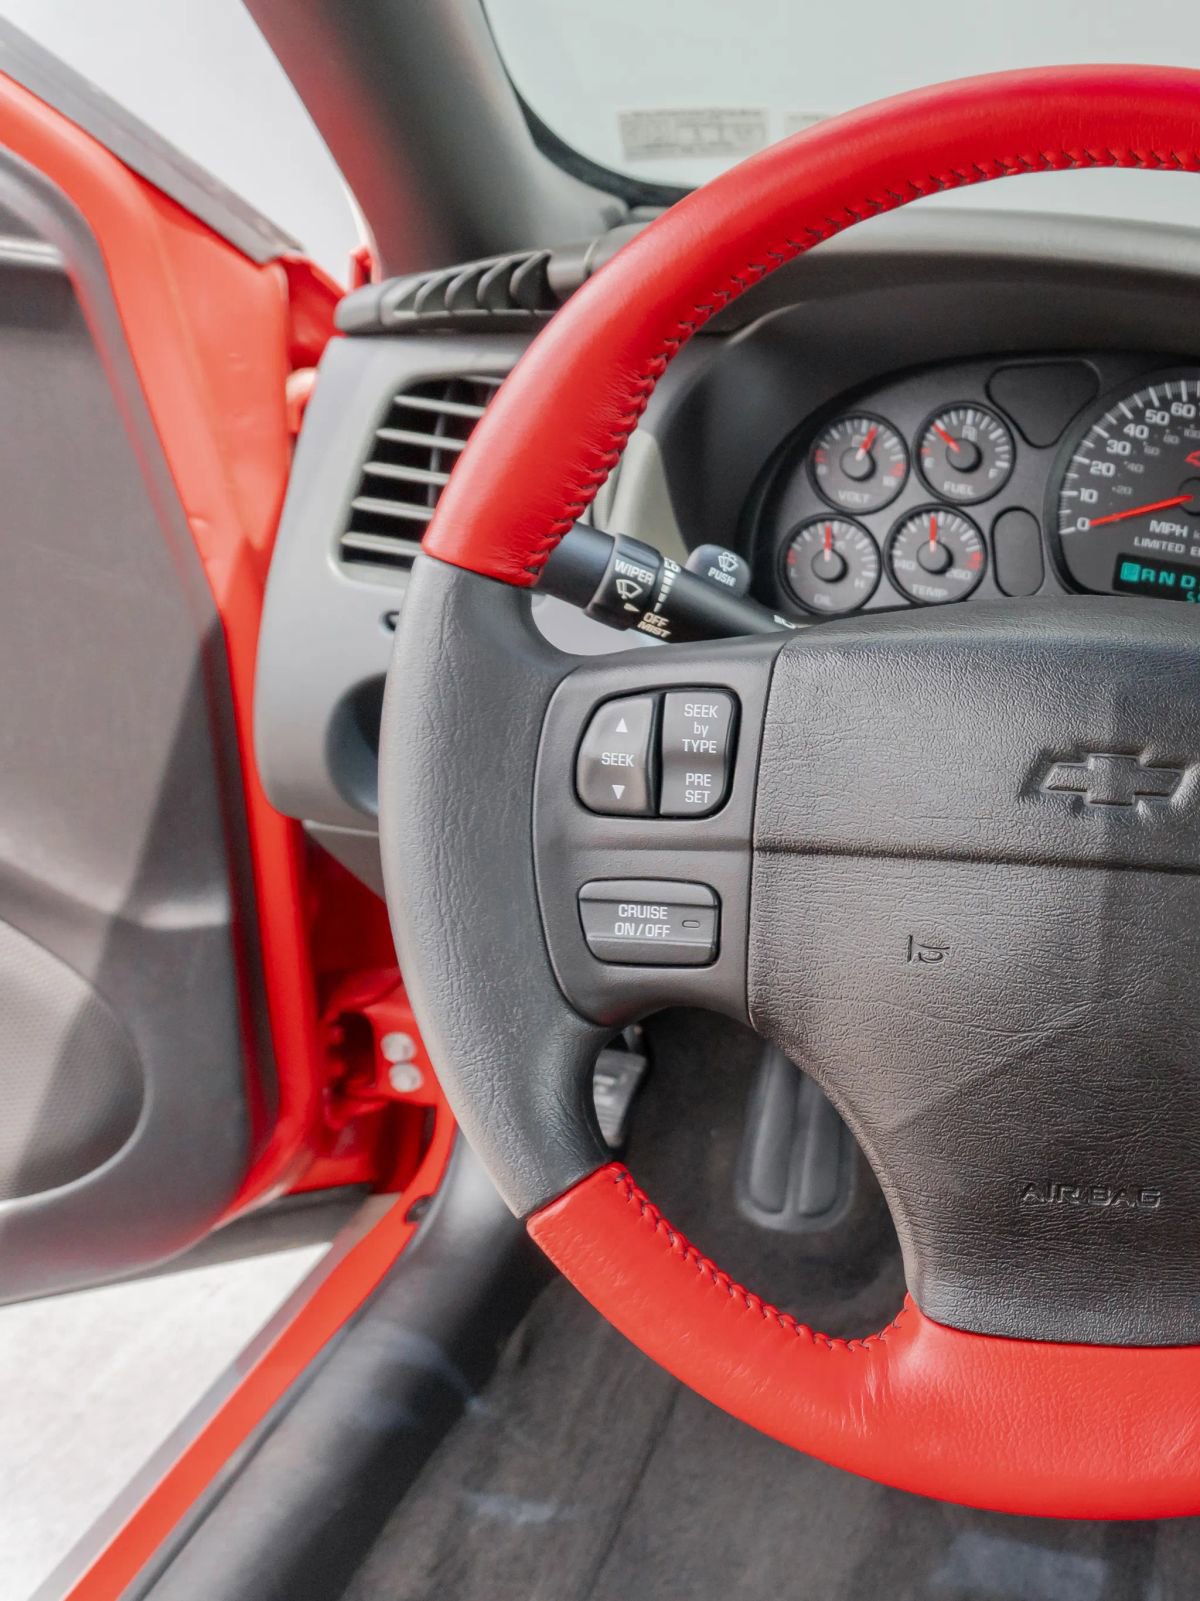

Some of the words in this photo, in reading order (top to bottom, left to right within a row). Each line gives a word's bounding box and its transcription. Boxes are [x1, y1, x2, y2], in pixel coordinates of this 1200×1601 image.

[1145, 410, 1170, 426] 50
[1171, 402, 1196, 418] 60
[1123, 423, 1149, 439] 40
[1106, 440, 1131, 456] 30
[1090, 460, 1115, 477] 20
[944, 481, 975, 496] FUEL
[1080, 488, 1098, 503] 10
[1076, 517, 1091, 532] 0
[1150, 520, 1188, 537] MPH
[1134, 536, 1186, 554] LIMITED
[614, 559, 655, 585] WIPER
[708, 567, 736, 587] PUSH
[643, 612, 670, 627] OFF
[637, 620, 672, 638] MIST
[684, 704, 719, 718] SEEK
[693, 722, 709, 738] by
[682, 739, 717, 754] TYPE
[601, 753, 635, 767] SEEK
[685, 773, 711, 787] PRE
[685, 790, 711, 804] SET
[618, 904, 668, 920] CRUISE
[1021, 1183, 1161, 1209] AIRBAG
